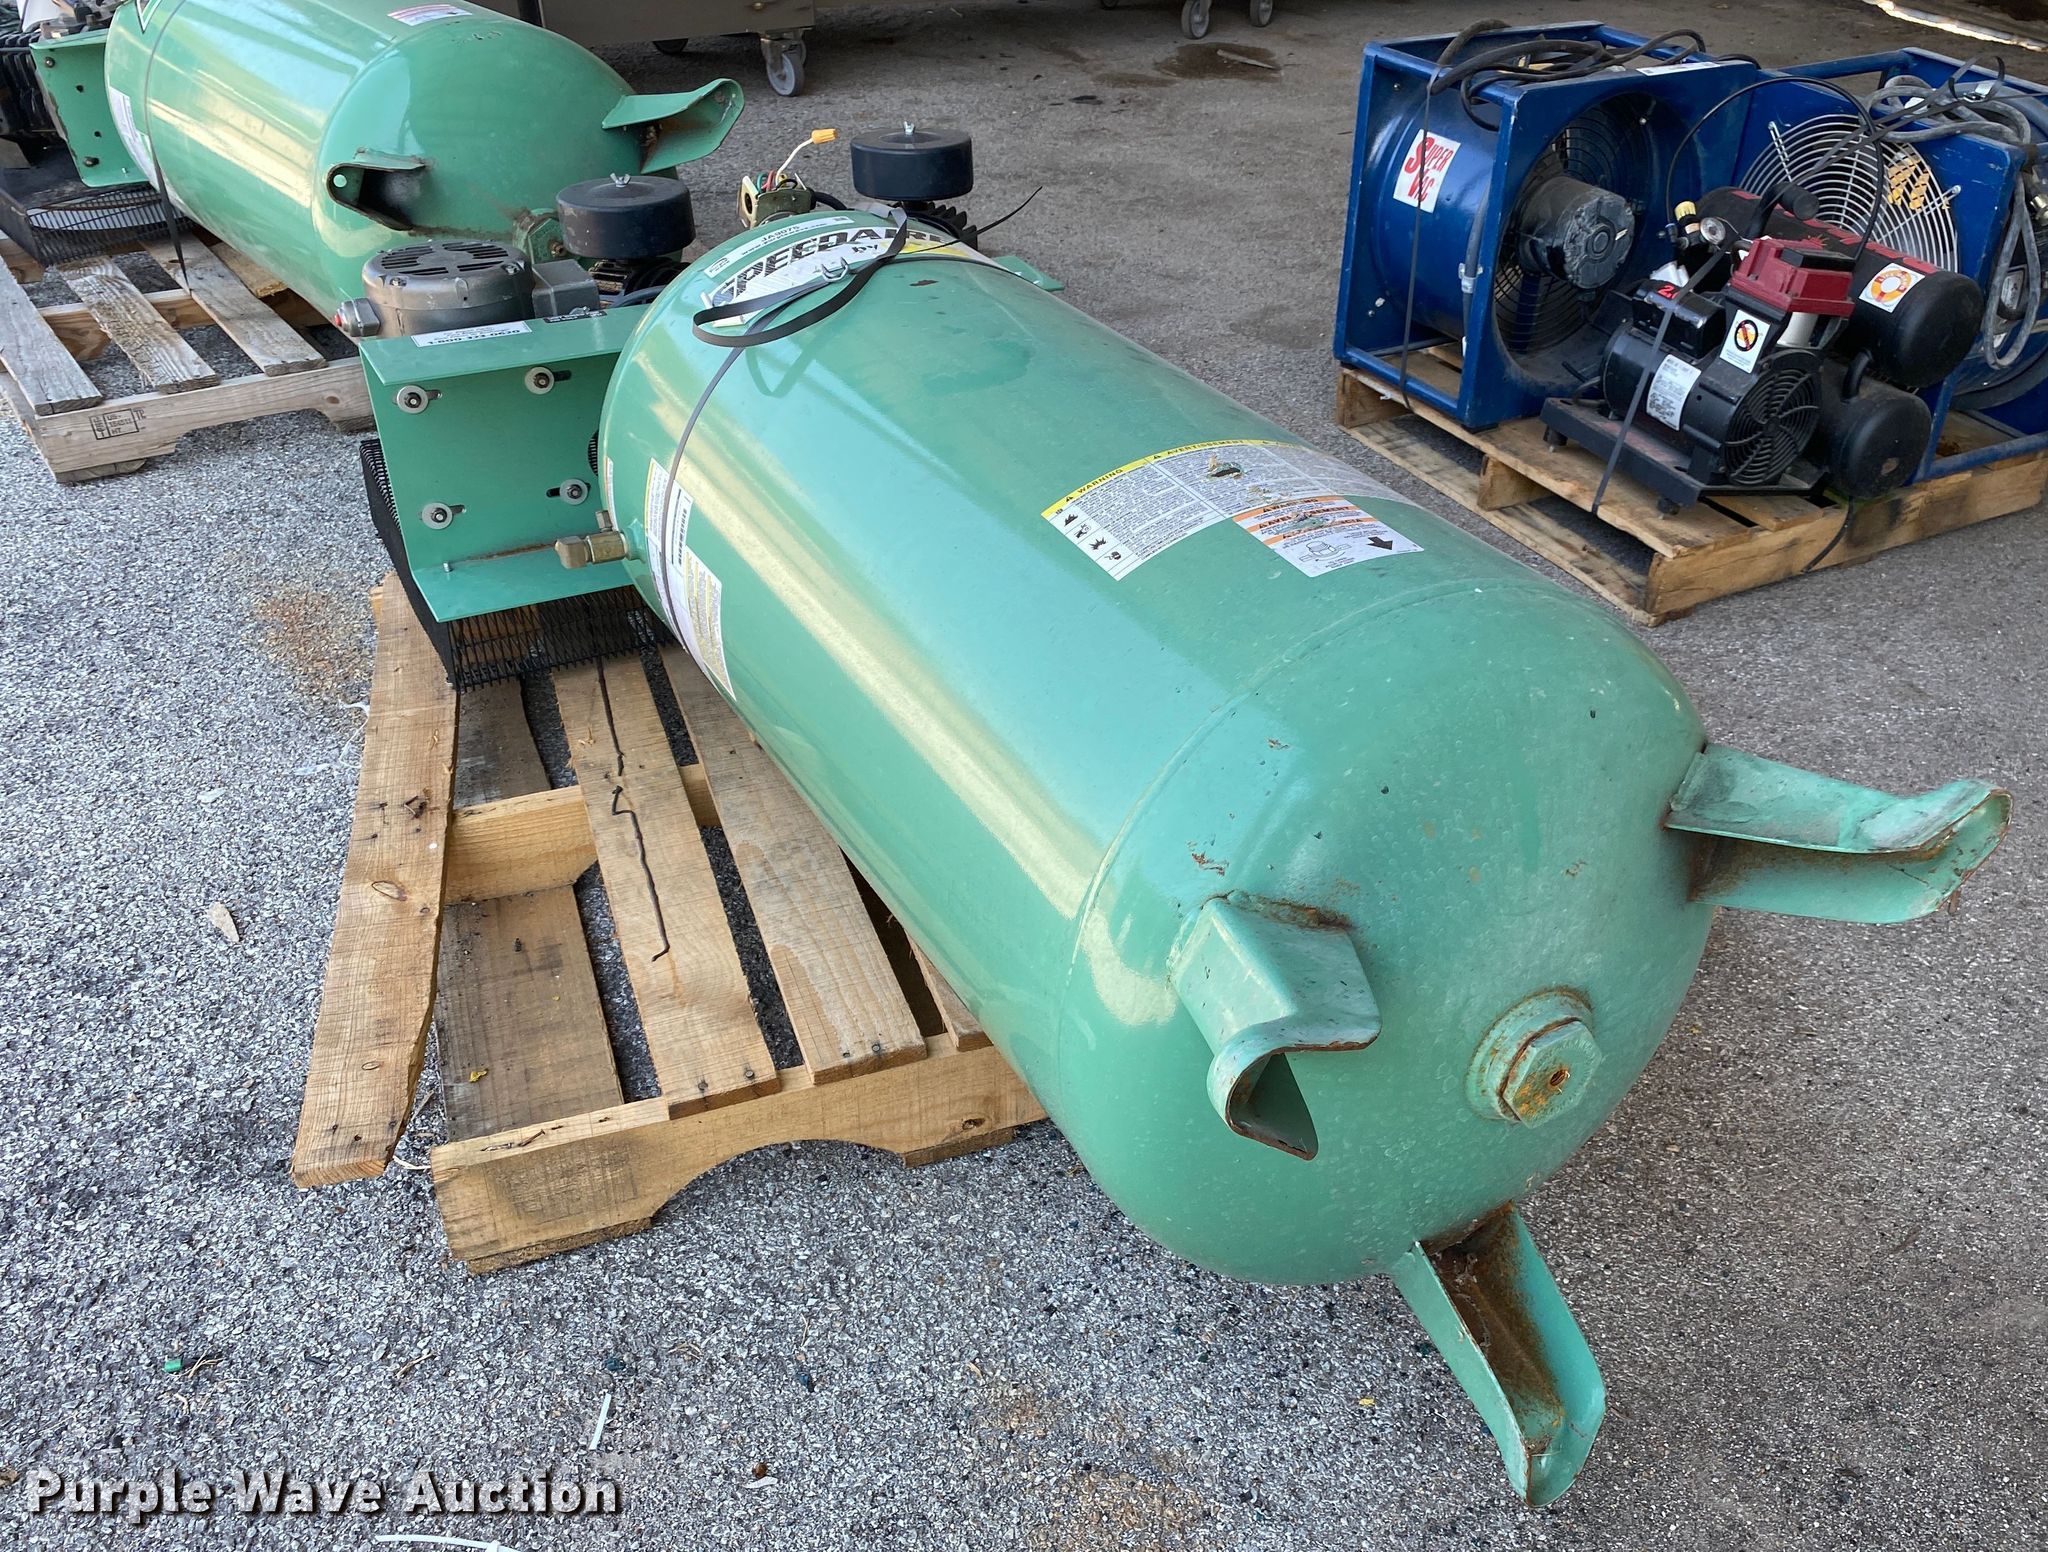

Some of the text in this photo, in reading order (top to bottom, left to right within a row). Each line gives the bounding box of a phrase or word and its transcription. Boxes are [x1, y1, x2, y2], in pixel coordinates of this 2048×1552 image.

[1404, 136, 1454, 174] SUPER
[1166, 440, 1244, 456] AVERTISSEMENT
[1077, 468, 1124, 494] WARNING
[1268, 506, 1350, 526] AVESEMENT
